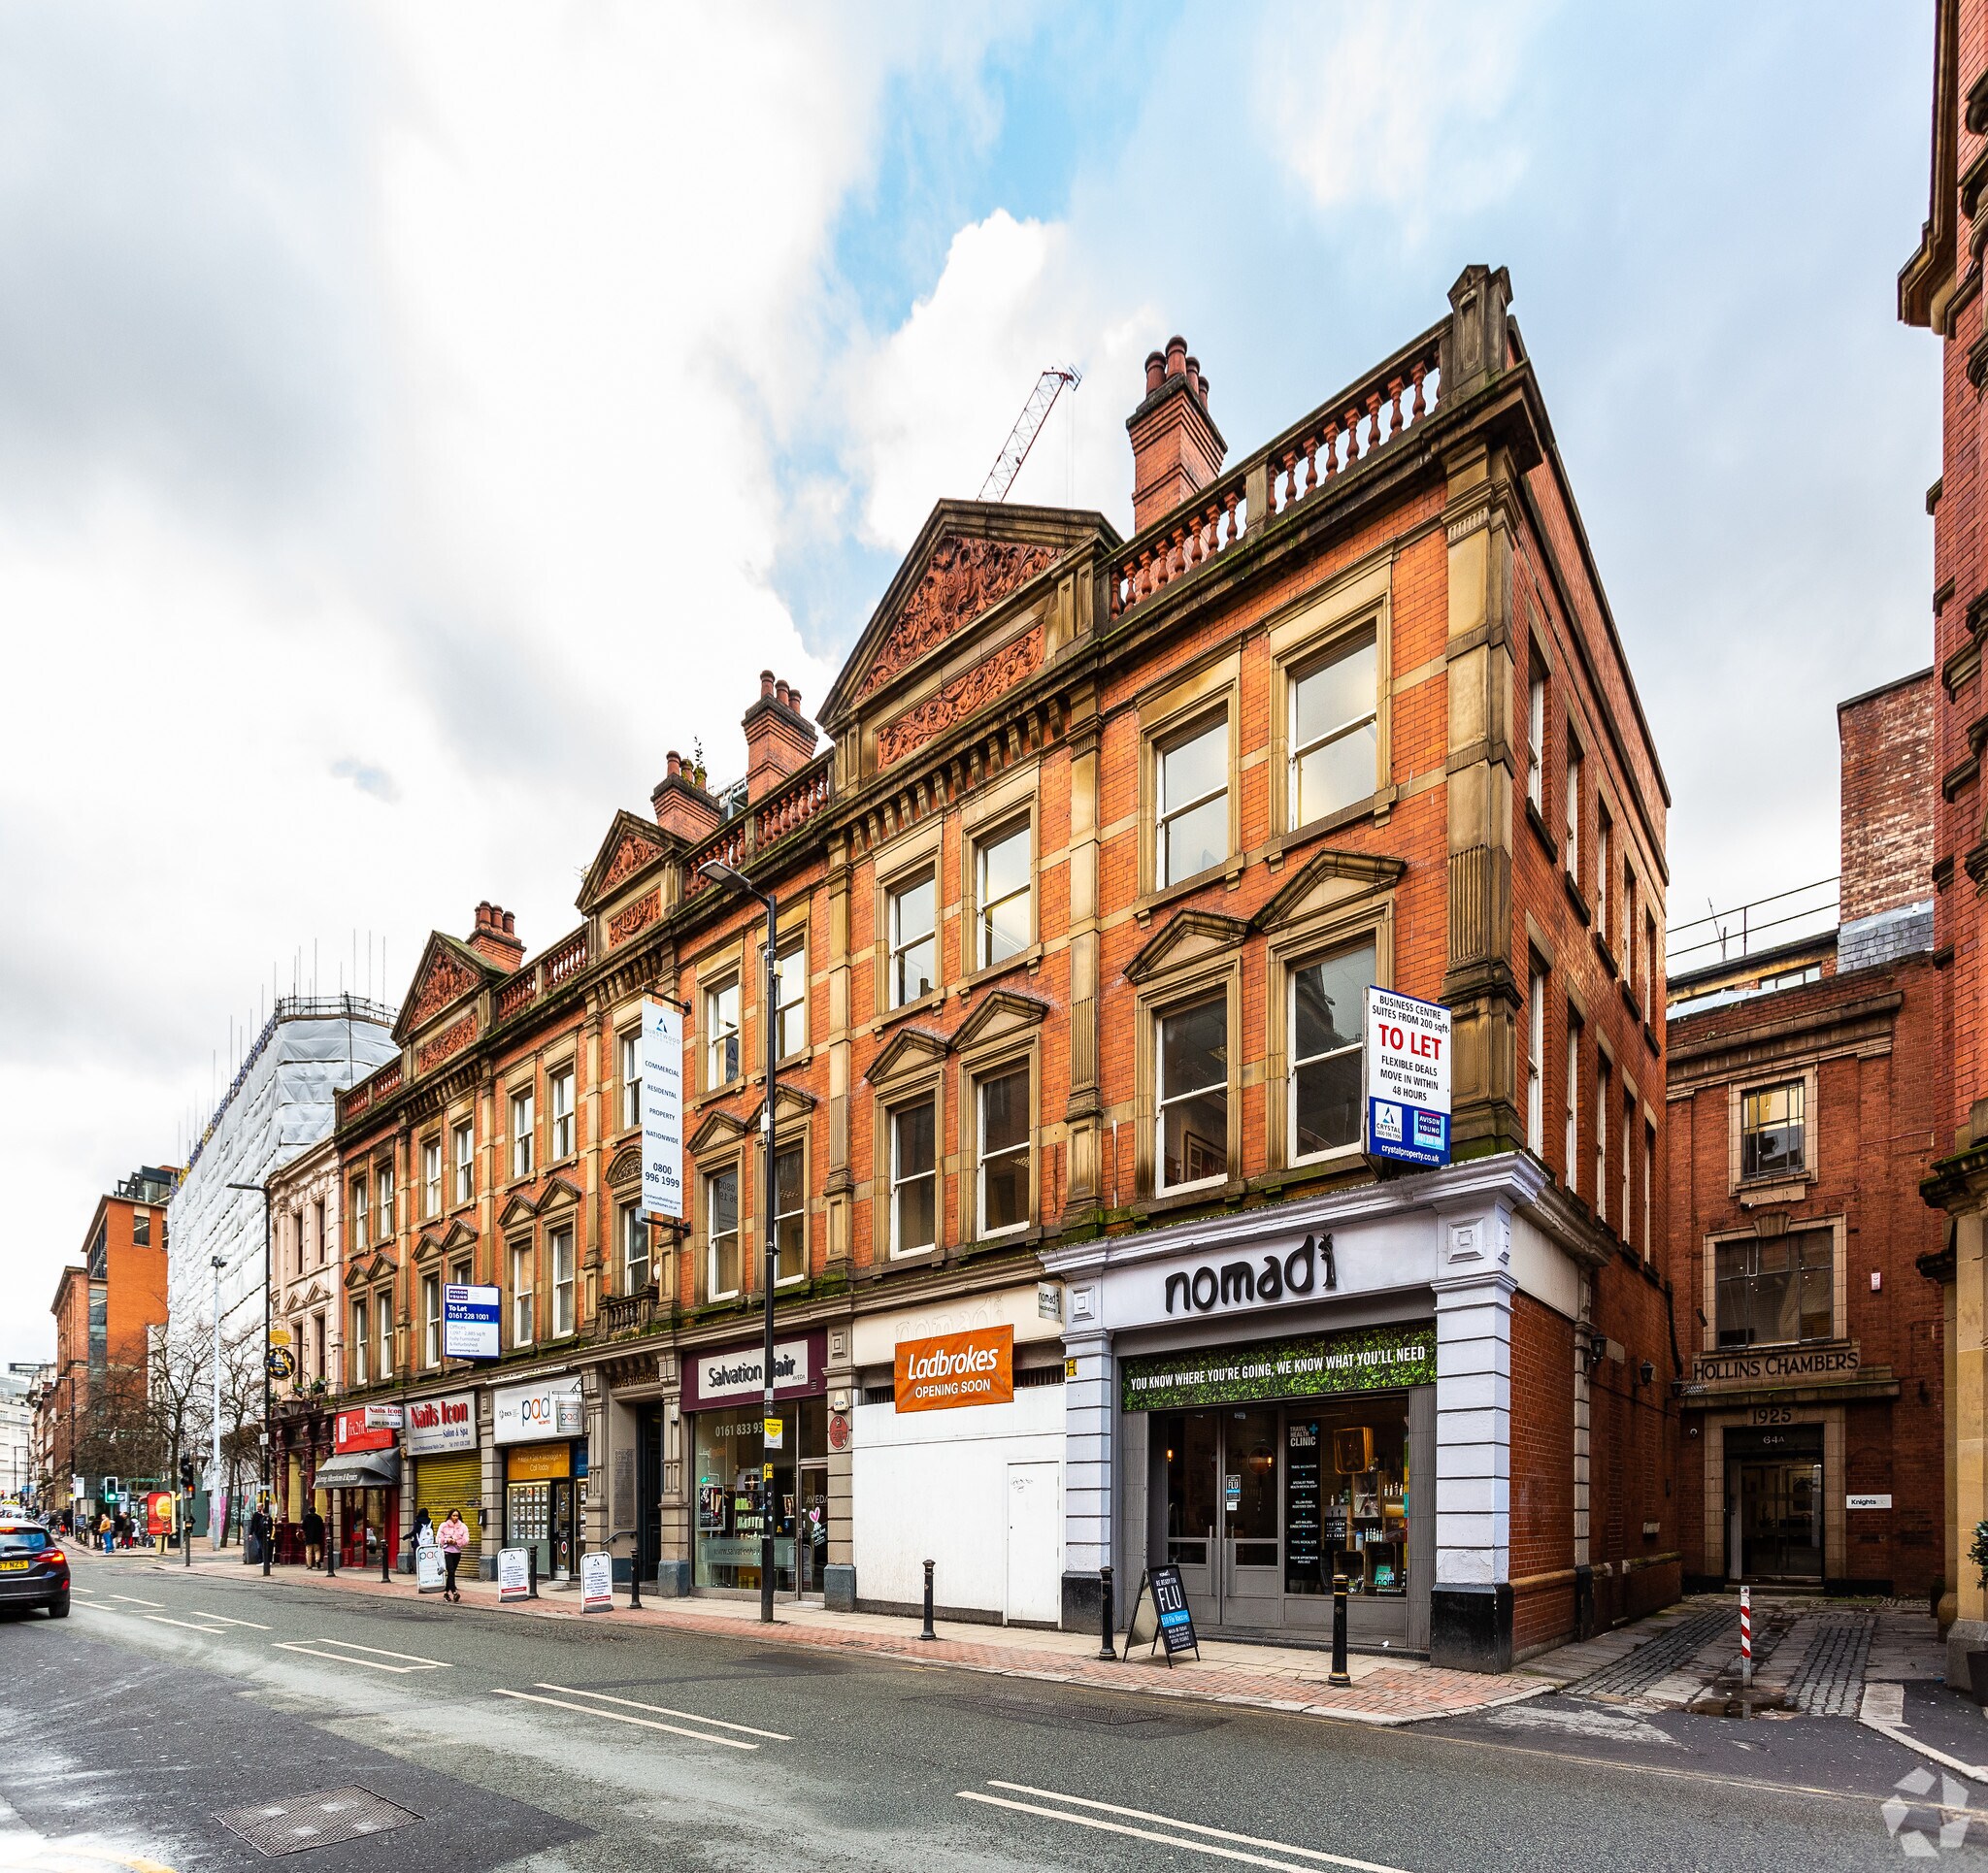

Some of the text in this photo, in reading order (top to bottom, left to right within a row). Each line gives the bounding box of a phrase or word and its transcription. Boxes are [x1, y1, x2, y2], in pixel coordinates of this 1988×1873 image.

[1373, 1005, 1396, 1019] SUITES
[1398, 1012, 1418, 1025] FROM
[1420, 1018, 1433, 1029] 200
[1380, 996, 1441, 1020] BUSINESS CENTRE
[1378, 1024, 1441, 1060] TO LET
[645, 1060, 679, 1077] COMMERCIAL
[1381, 1055, 1438, 1076] FLEXIBLE DEALS
[1380, 1069, 1439, 1091] MOVE IN WITHIN
[1392, 1086, 1427, 1101] 48 HOURS
[649, 1108, 676, 1121] PROPERTY
[1419, 1115, 1440, 1126] AVISON
[646, 1130, 679, 1145] NATIONWIDE
[1376, 1123, 1401, 1134] CRYSTAL
[1419, 1124, 1440, 1134] YOUNG
[1381, 1144, 1440, 1163] crystalproperty.co.uk
[653, 1163, 672, 1175] 0800
[646, 1171, 679, 1189] 996 1999
[1039, 1292, 1055, 1304] nomad
[709, 1354, 796, 1388] Salvation air
[908, 1345, 999, 1381] Ladbrokes
[1131, 1346, 1425, 1391] YOU KNOW WHERE YOU'RE GOING, WE KNOW WHAT YOU'LL NEED
[1694, 1352, 1858, 1380] HOLLINS CHAMBERS
[915, 1378, 991, 1398] OPENING SOON
[411, 1400, 468, 1430] Nails Icon
[522, 1391, 550, 1427] pad
[1753, 1408, 1792, 1425] 1925
[715, 1426, 734, 1437] 0161
[737, 1423, 751, 1435] 833
[753, 1422, 764, 1434] 93
[1290, 1436, 1316, 1447] CLINIC
[1763, 1435, 1785, 1444] 64A
[1228, 1481, 1239, 1490] FLU
[1157, 1585, 1182, 1612] FLU
